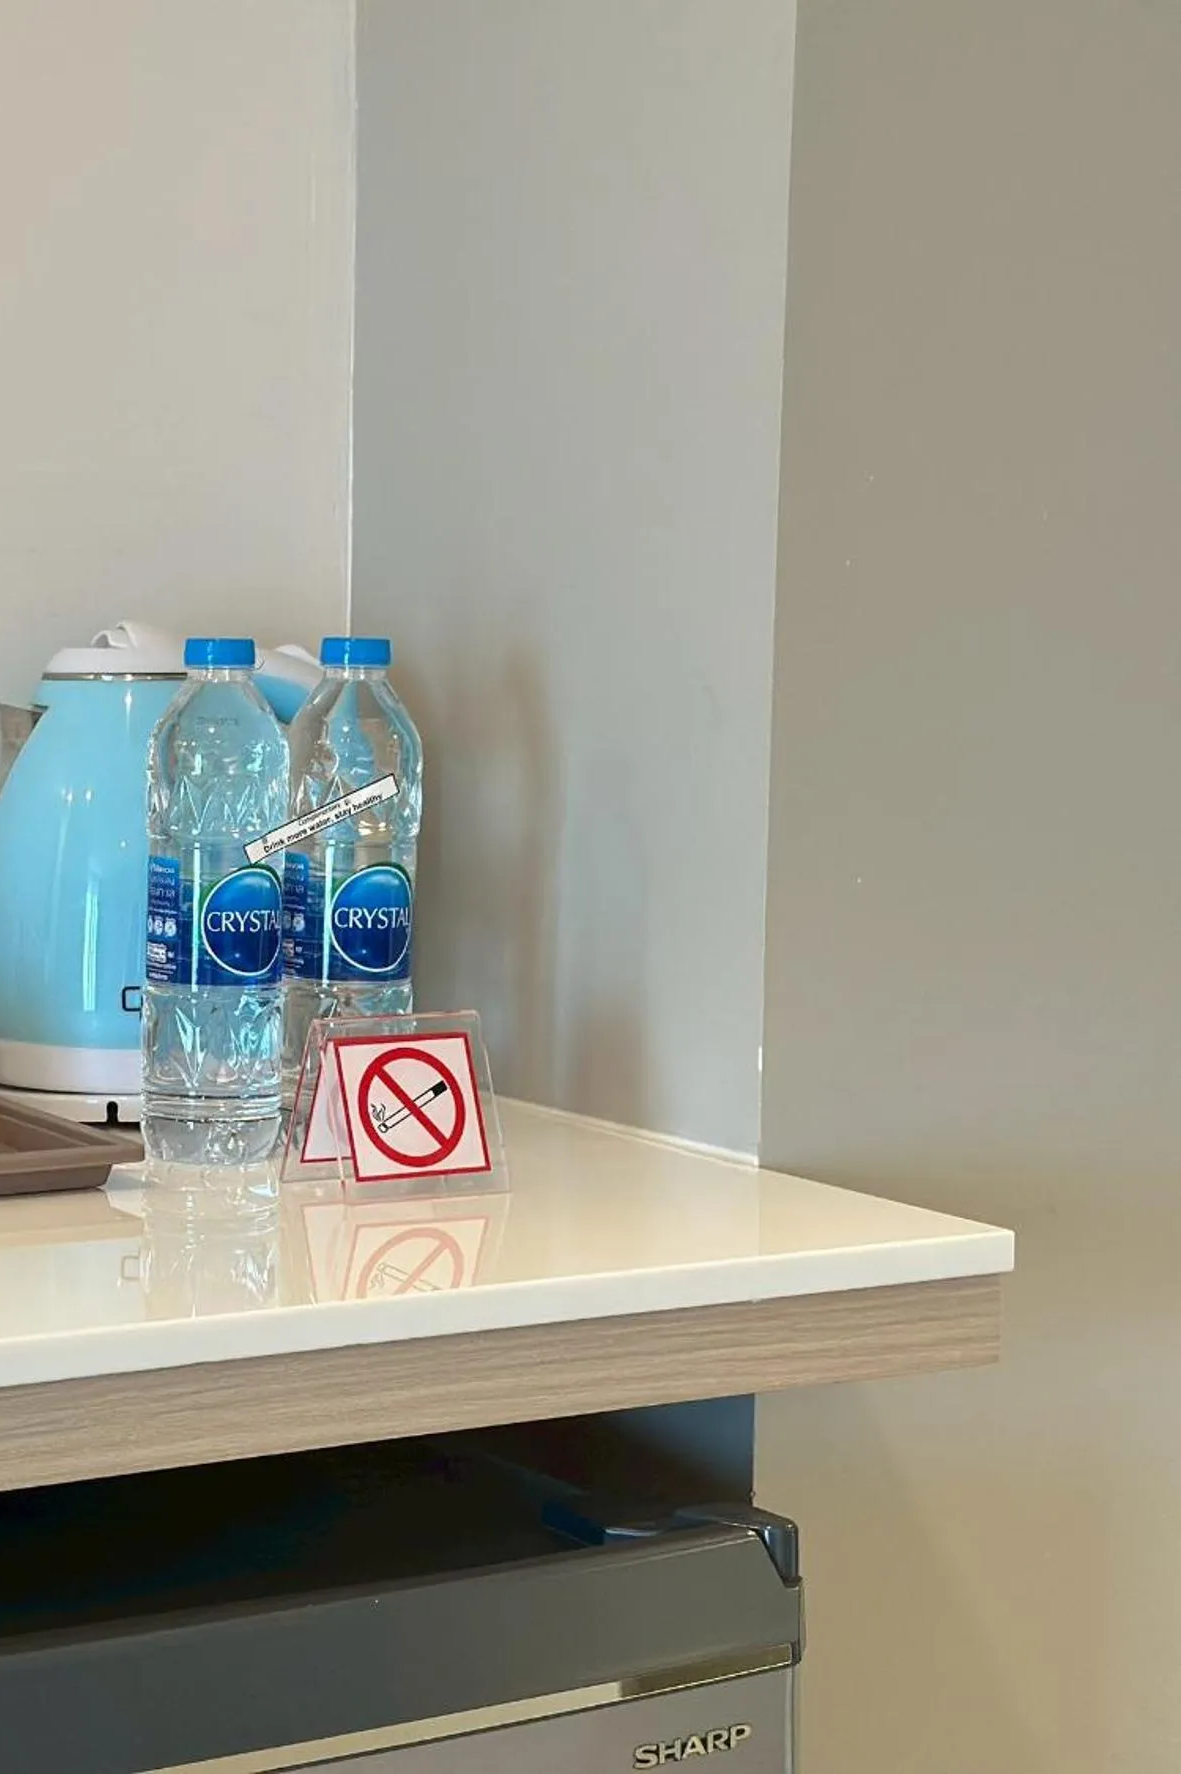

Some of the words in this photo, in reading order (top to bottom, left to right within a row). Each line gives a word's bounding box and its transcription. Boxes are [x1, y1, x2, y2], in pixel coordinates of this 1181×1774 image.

[264, 839, 285, 853] Drink
[287, 828, 308, 843] more
[334, 806, 353, 820] stay
[353, 793, 383, 811] healthy
[334, 906, 410, 930] CRYSTAL
[633, 1723, 752, 1769] SHARP
